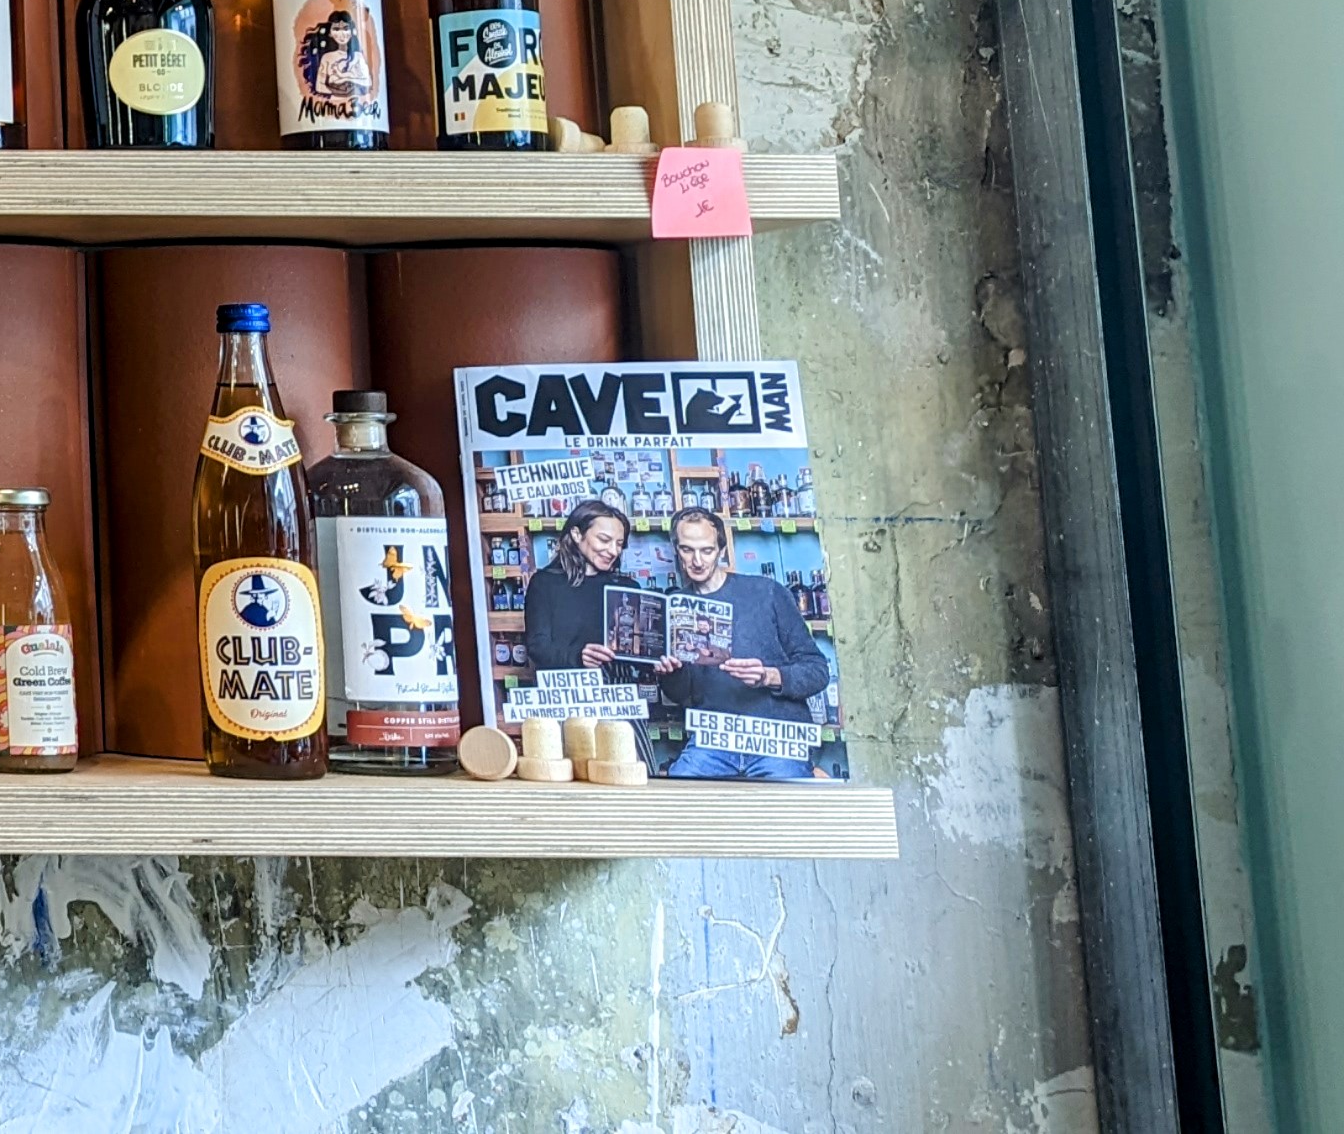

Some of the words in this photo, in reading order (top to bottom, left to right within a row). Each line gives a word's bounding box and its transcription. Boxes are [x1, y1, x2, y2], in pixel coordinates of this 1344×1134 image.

[132, 53, 158, 68] PETIT
[160, 50, 186, 68] BÉRET
[475, 372, 672, 438] CAVE
[760, 372, 793, 433] MAN
[564, 437, 581, 448] LE
[587, 437, 628, 448] DRINK
[634, 436, 694, 448] PARFAIT
[496, 459, 593, 488] TECHNIQUE
[509, 488, 525, 501] LE
[526, 481, 586, 499] CALVADOS
[356, 526, 398, 534] DISTILLED
[670, 596, 710, 613] CAVE
[215, 634, 313, 667] CLUB-
[19, 665, 47, 677] Cold
[47, 666, 68, 677] Brew
[542, 670, 600, 688] VISITES
[12, 676, 46, 687] Green
[47, 676, 72, 687] Coffee
[218, 668, 314, 701] MATE
[513, 689, 533, 706] DE
[538, 686, 635, 705] DISTILLERIES
[249, 708, 288, 721] Original
[383, 716, 416, 726] COPPER
[417, 717, 437, 725] STILL
[518, 706, 566, 720] LONDRES
[584, 705, 597, 717] EN
[600, 704, 644, 717] IRLANDE
[689, 711, 718, 731] LES
[723, 714, 818, 743] SÉLECTIONS
[700, 729, 729, 748] DES
[734, 734, 808, 759] CAVISTES
